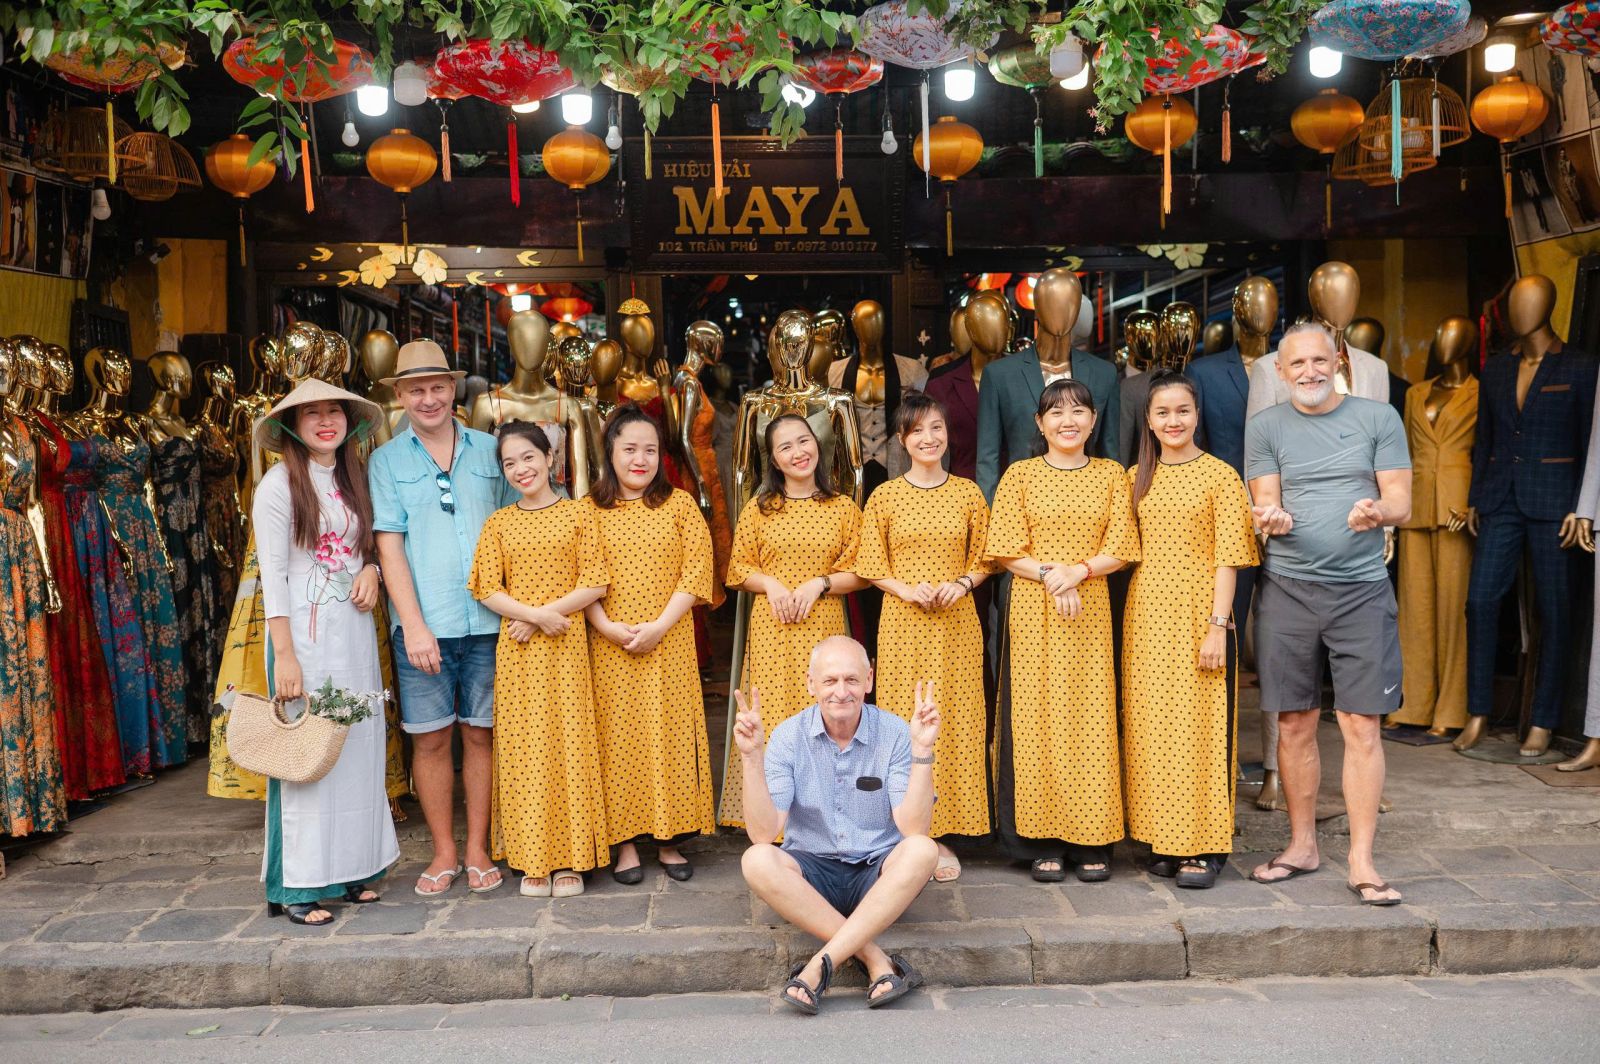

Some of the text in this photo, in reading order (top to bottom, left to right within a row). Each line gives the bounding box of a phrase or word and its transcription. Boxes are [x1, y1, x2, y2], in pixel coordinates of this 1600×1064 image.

[664, 160, 712, 182] HIỆU
[672, 186, 870, 235] MAYA
[658, 241, 684, 252] 102
[730, 237, 758, 252] PHÚ
[831, 241, 878, 252] 010177
